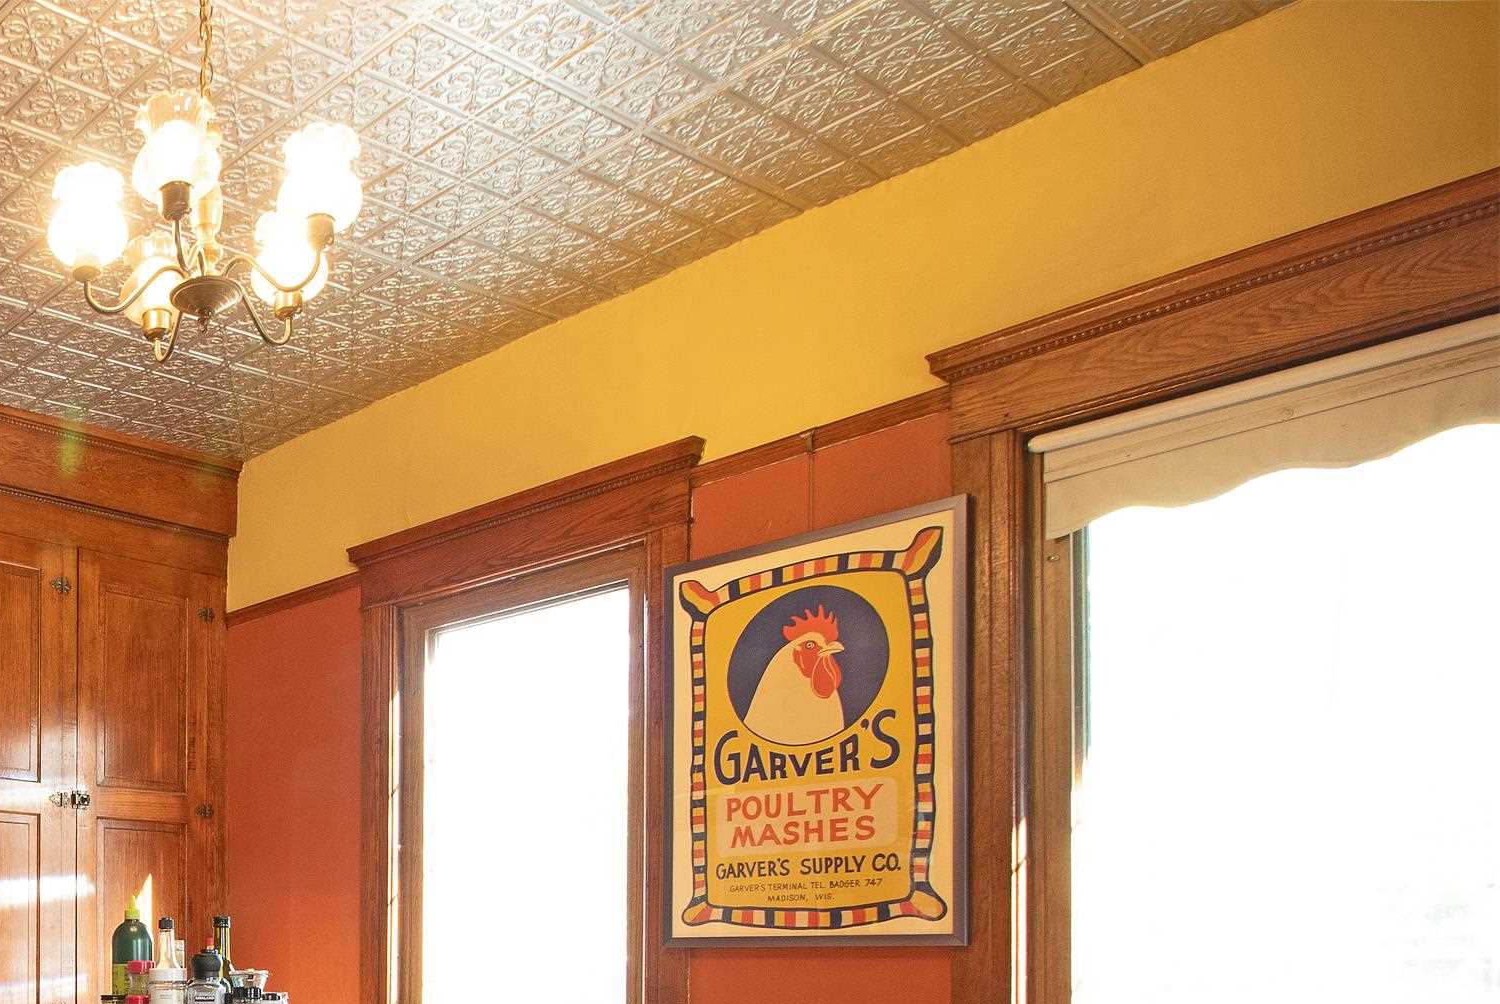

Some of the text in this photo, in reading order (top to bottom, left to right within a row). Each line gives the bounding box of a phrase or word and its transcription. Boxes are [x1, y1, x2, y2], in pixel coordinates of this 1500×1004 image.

[713, 708, 900, 786] GARVER'S
[726, 783, 884, 822] POULTRY
[730, 815, 876, 849] MASHES
[715, 852, 902, 880] GARVER'S SUPPLY CO.
[729, 883, 766, 893] GARVER'S
[768, 882, 808, 892] TERMINAL
[829, 879, 861, 889] BADGER
[863, 877, 884, 887] 747
[767, 892, 836, 903] MADISON, WIS.
